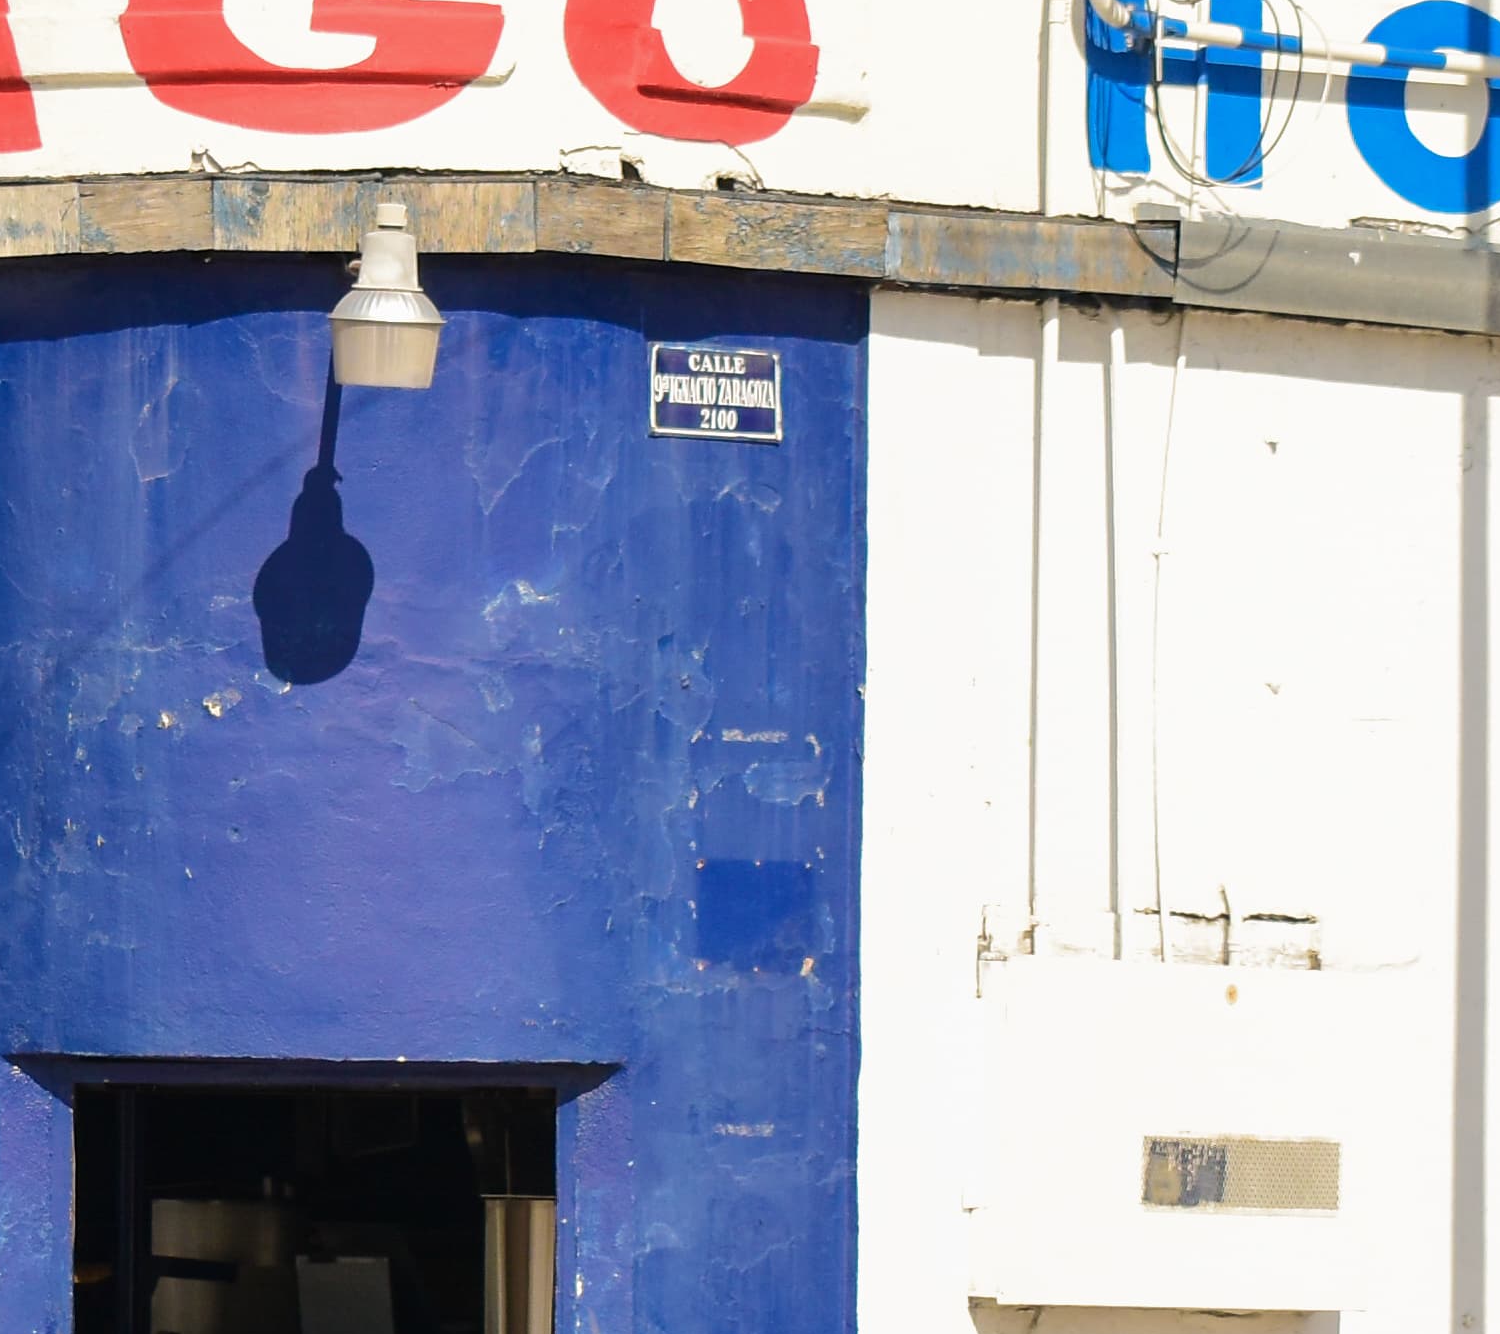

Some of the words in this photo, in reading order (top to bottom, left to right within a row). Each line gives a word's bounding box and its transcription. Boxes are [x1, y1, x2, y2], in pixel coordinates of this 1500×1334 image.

[688, 353, 746, 375] CALLE
[717, 378, 775, 409] ZARAGOZA
[700, 408, 738, 430] 2100
